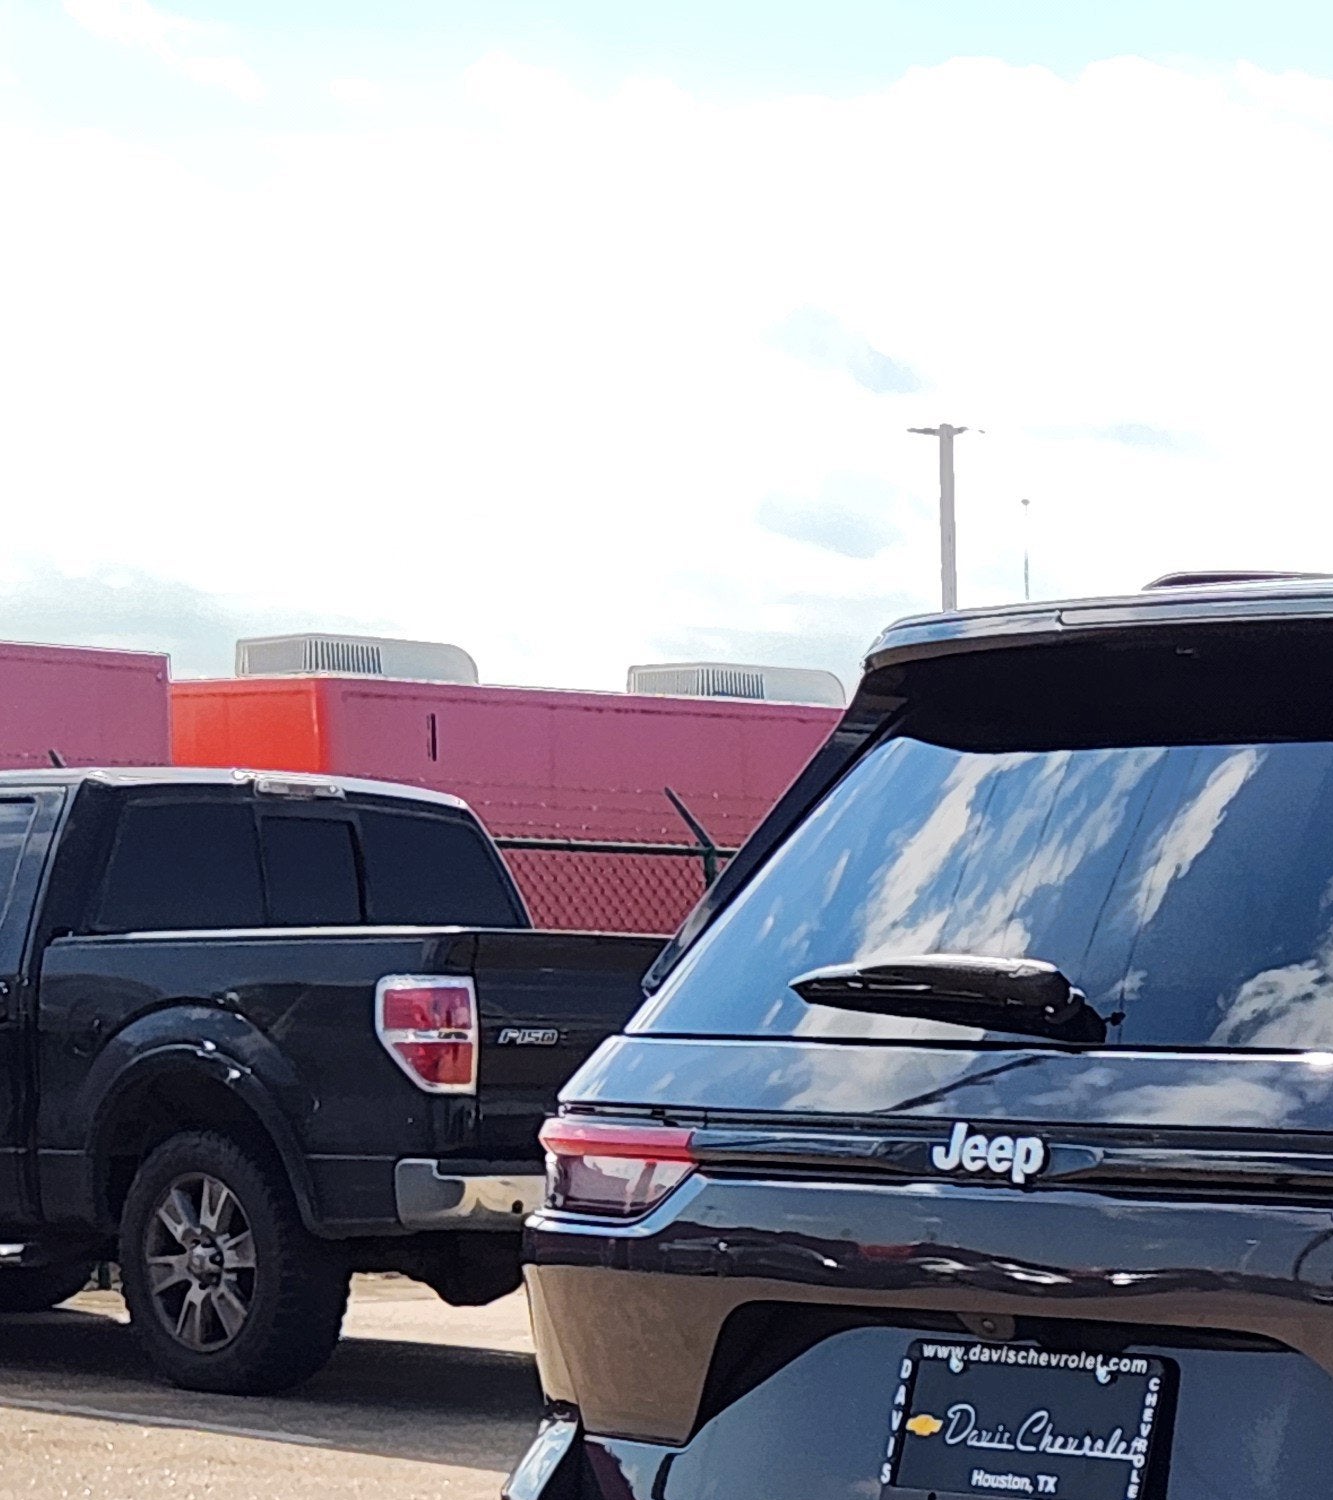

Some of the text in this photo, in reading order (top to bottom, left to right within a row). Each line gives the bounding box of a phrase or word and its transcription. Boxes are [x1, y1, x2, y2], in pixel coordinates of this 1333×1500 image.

[932, 1121, 1045, 1184] Jeep
[922, 1343, 1148, 1375] www.davischevrolet.com
[880, 1358, 912, 1484] DAVIS
[945, 1403, 1015, 1450] Davis
[971, 1469, 1058, 1494] Houston, TX
